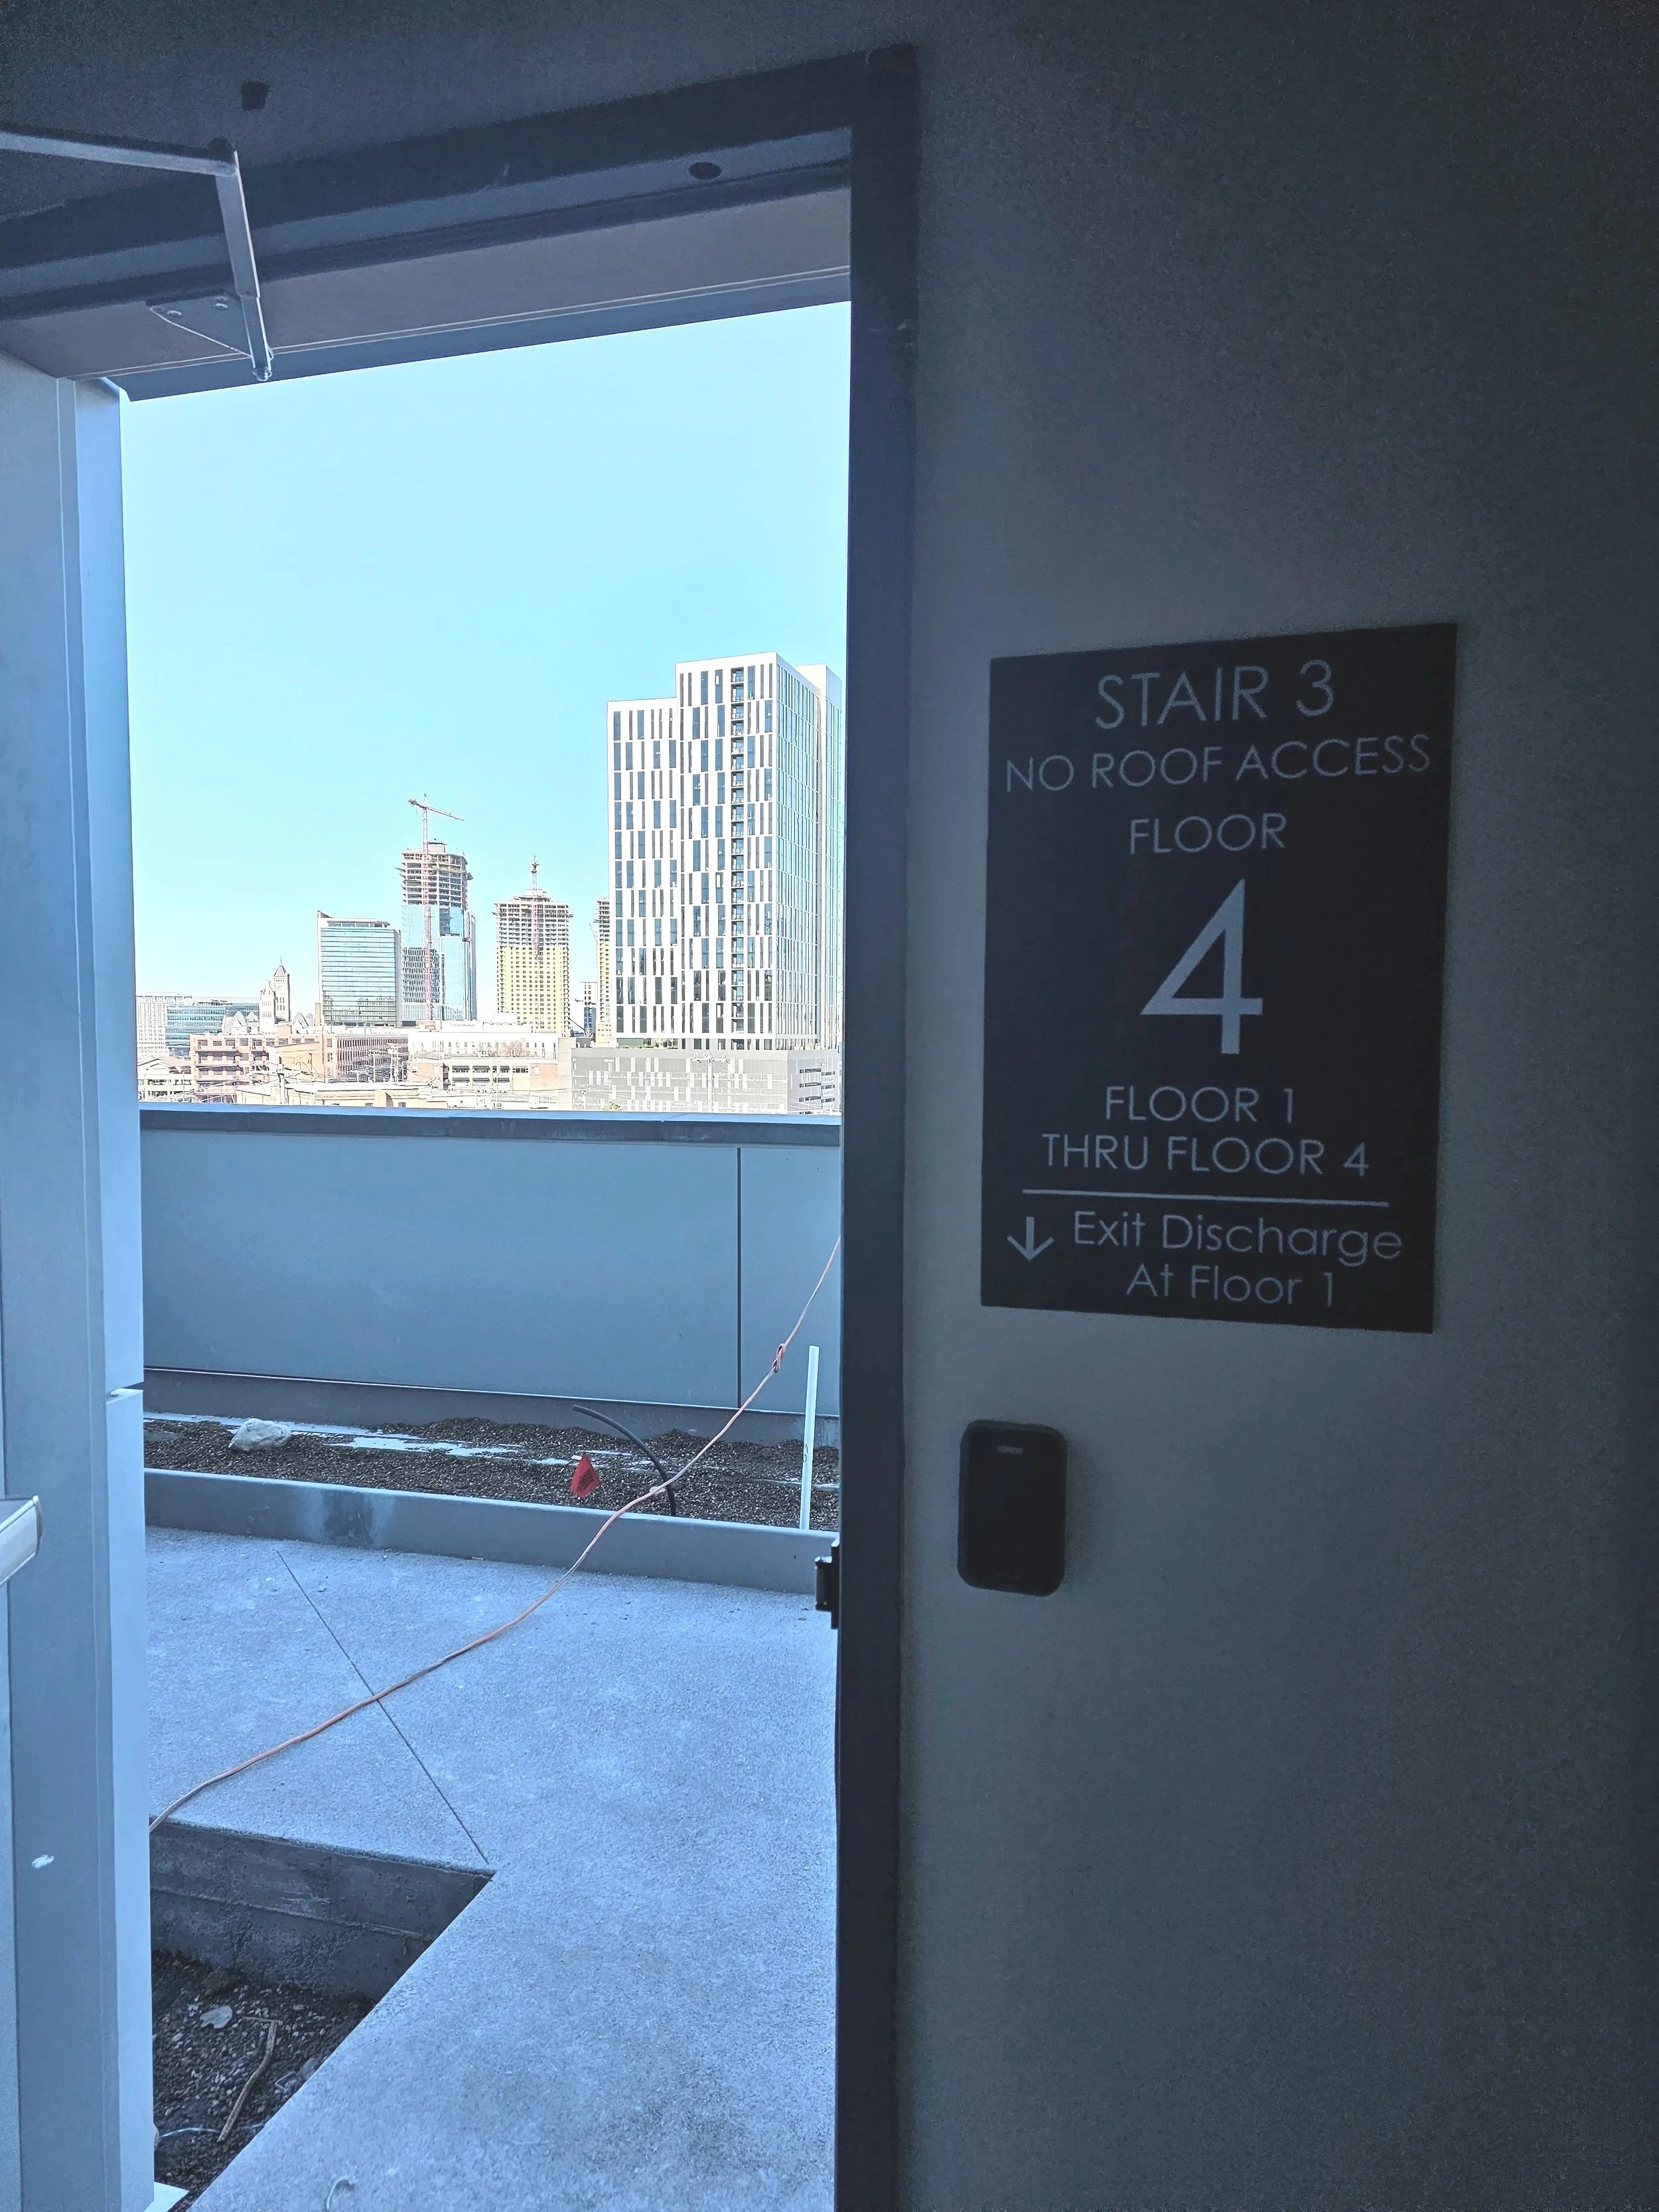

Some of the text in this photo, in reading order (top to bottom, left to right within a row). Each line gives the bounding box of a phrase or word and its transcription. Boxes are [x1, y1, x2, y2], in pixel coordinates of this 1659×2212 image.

[1096, 660, 1334, 729] STAIR 3
[1007, 733, 1431, 792] NO ROOF ACCESS
[1130, 814, 1287, 854] FLOOR
[1139, 879, 1263, 1055] 4
[1106, 1086, 1293, 1124] FLOOR 1
[1042, 1134, 1369, 1177] THRU FLOOR 4
[1074, 1211, 1402, 1267] Exit Discharge
[1126, 1263, 1334, 1307] At Floor 1
